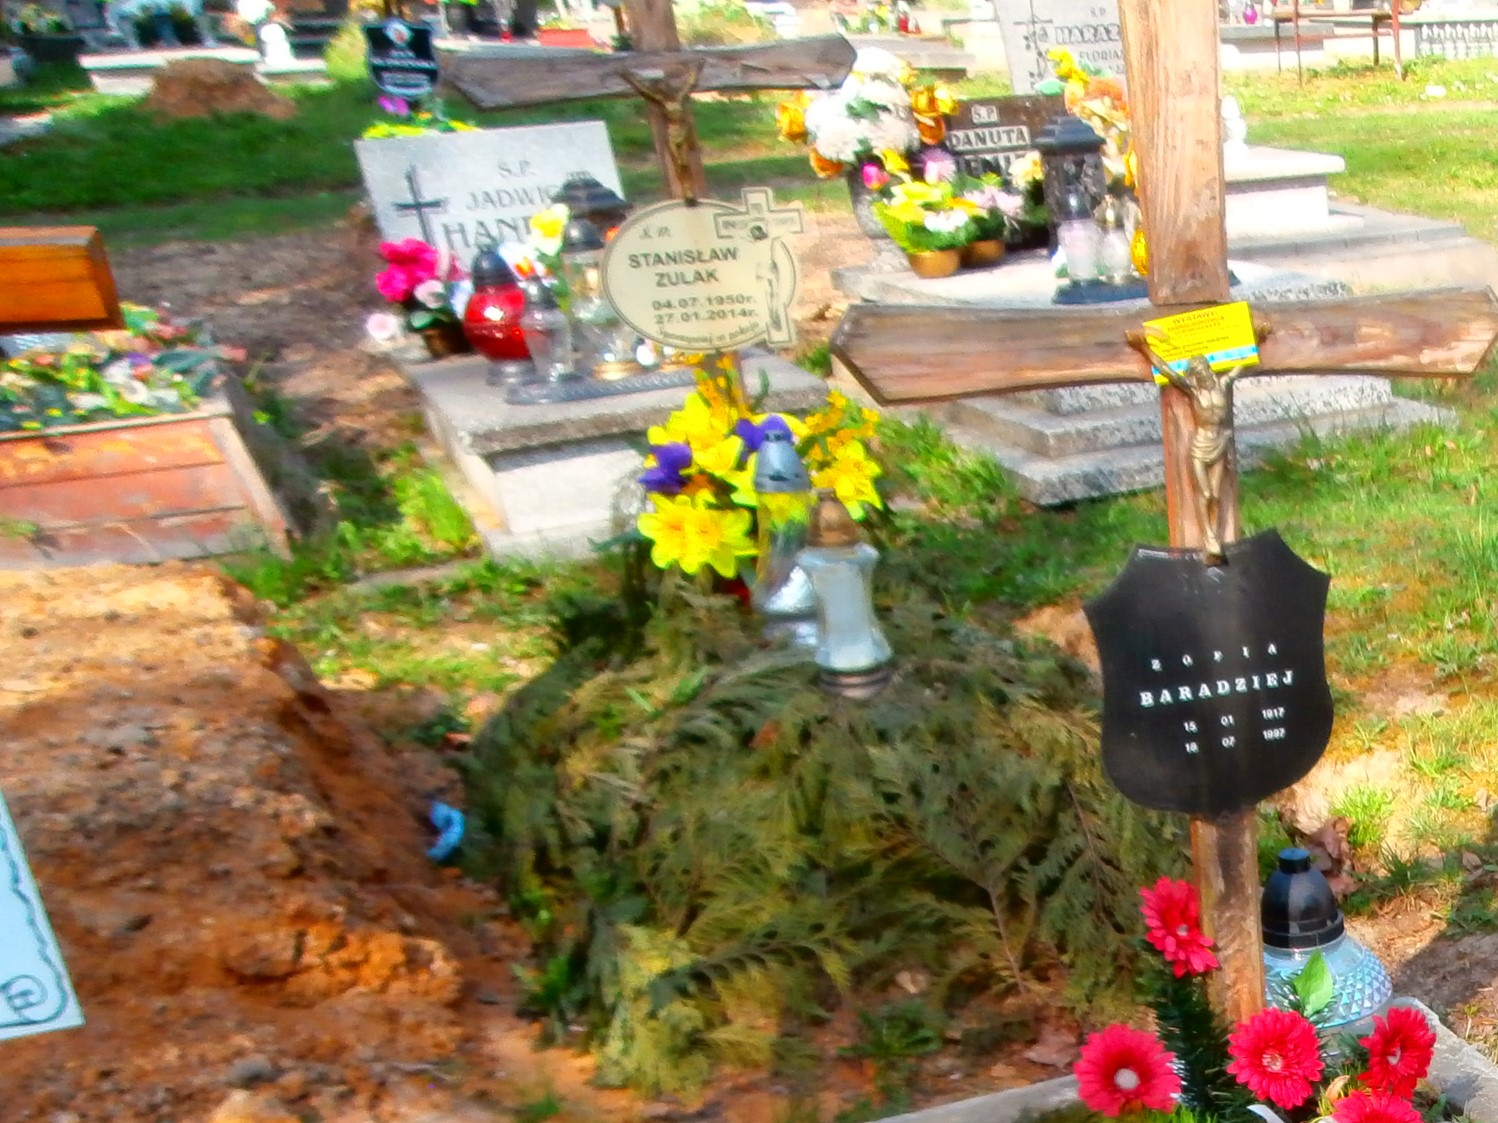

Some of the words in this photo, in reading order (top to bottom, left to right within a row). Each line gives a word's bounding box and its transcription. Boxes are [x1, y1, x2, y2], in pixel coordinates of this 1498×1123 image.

[1079, 50, 1124, 61] FLORIA
[950, 127, 1028, 148] DANUTA
[628, 246, 739, 270] STANISŁAW
[1139, 669, 1294, 708] BARADZIEJ
[1220, 714, 1235, 727] 01
